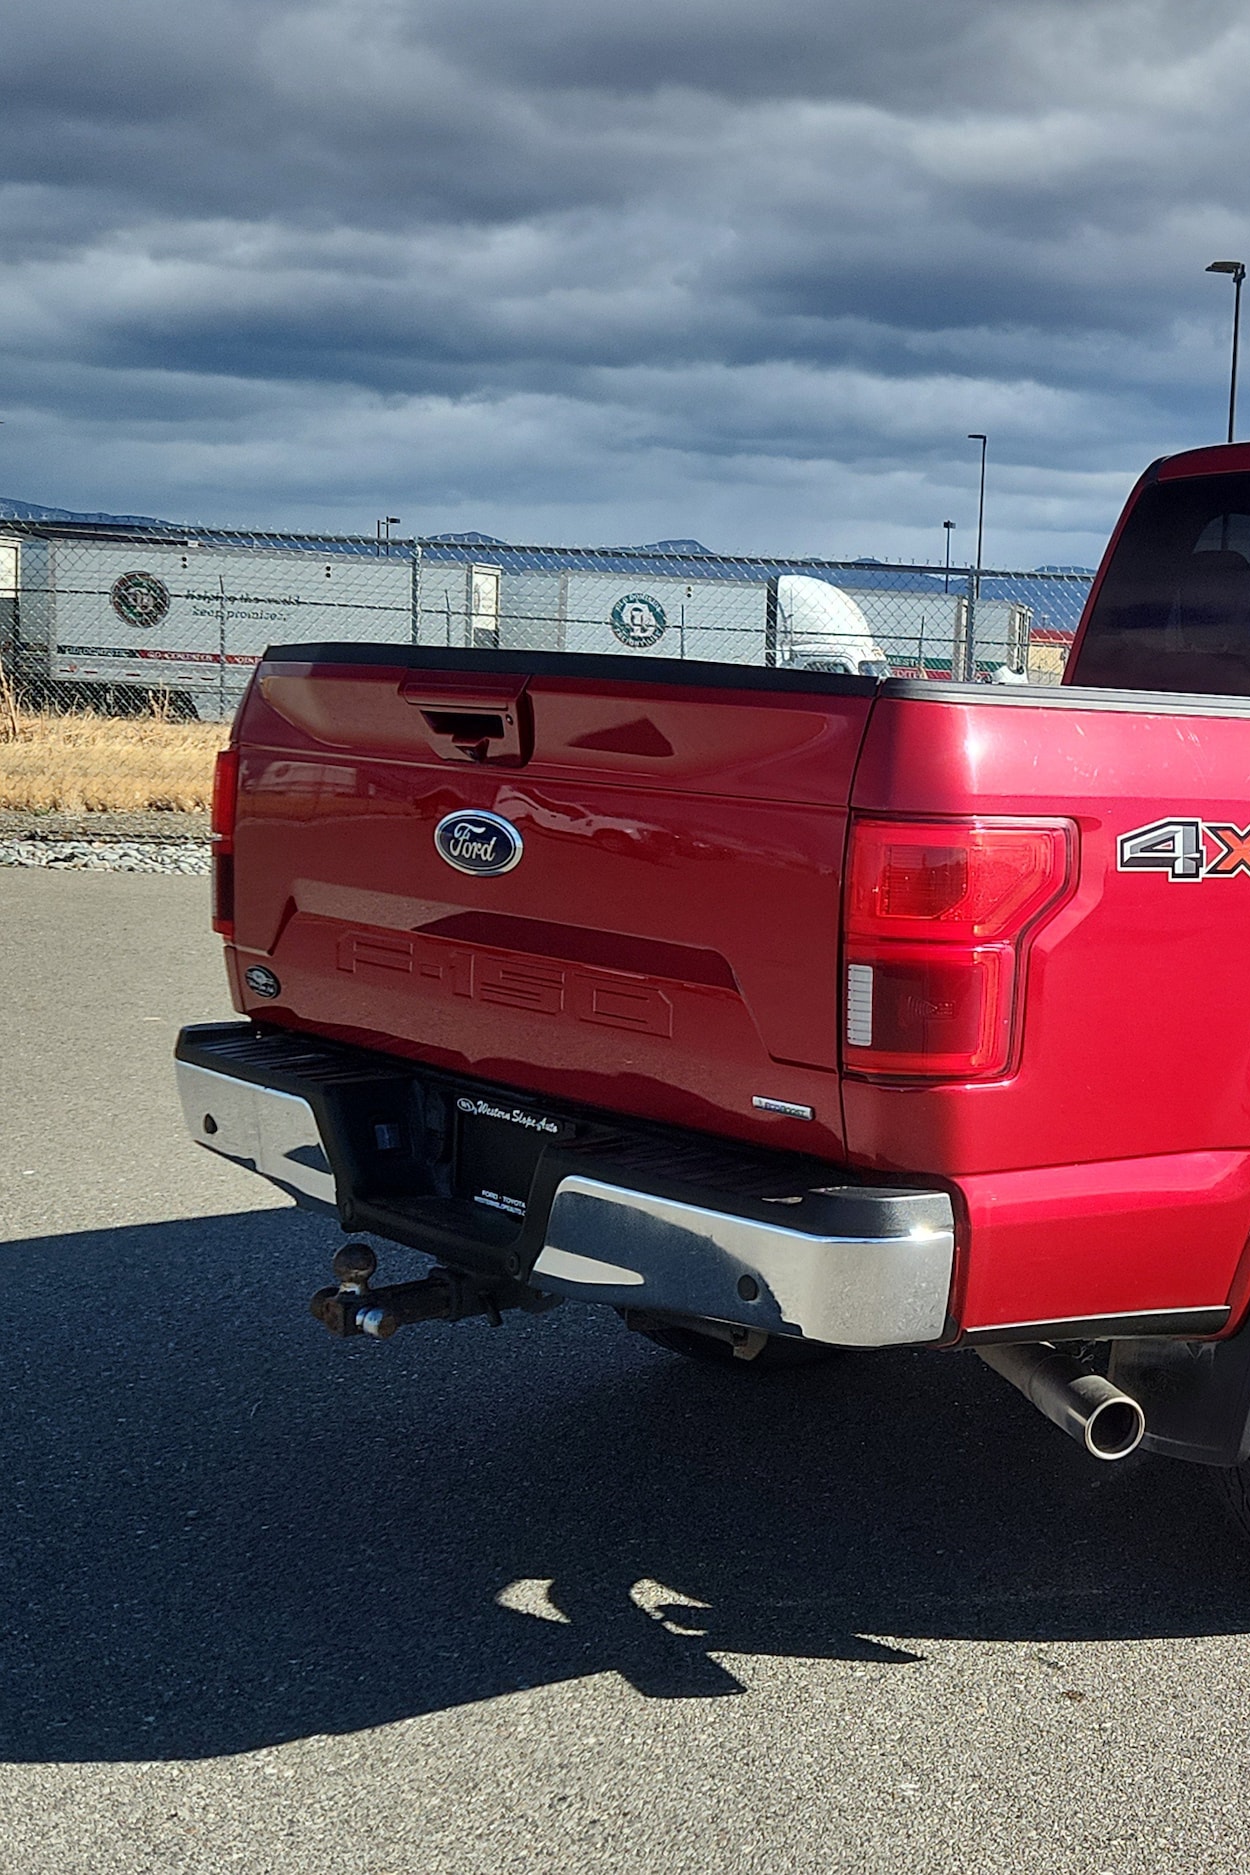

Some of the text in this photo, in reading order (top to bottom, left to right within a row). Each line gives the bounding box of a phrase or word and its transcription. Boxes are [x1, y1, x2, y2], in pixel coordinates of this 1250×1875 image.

[449, 822, 498, 862] Ford
[336, 928, 673, 1040] F-150
[476, 1100, 511, 1121] Western
[511, 1109, 536, 1129] Slope
[536, 1117, 558, 1134] Auto
